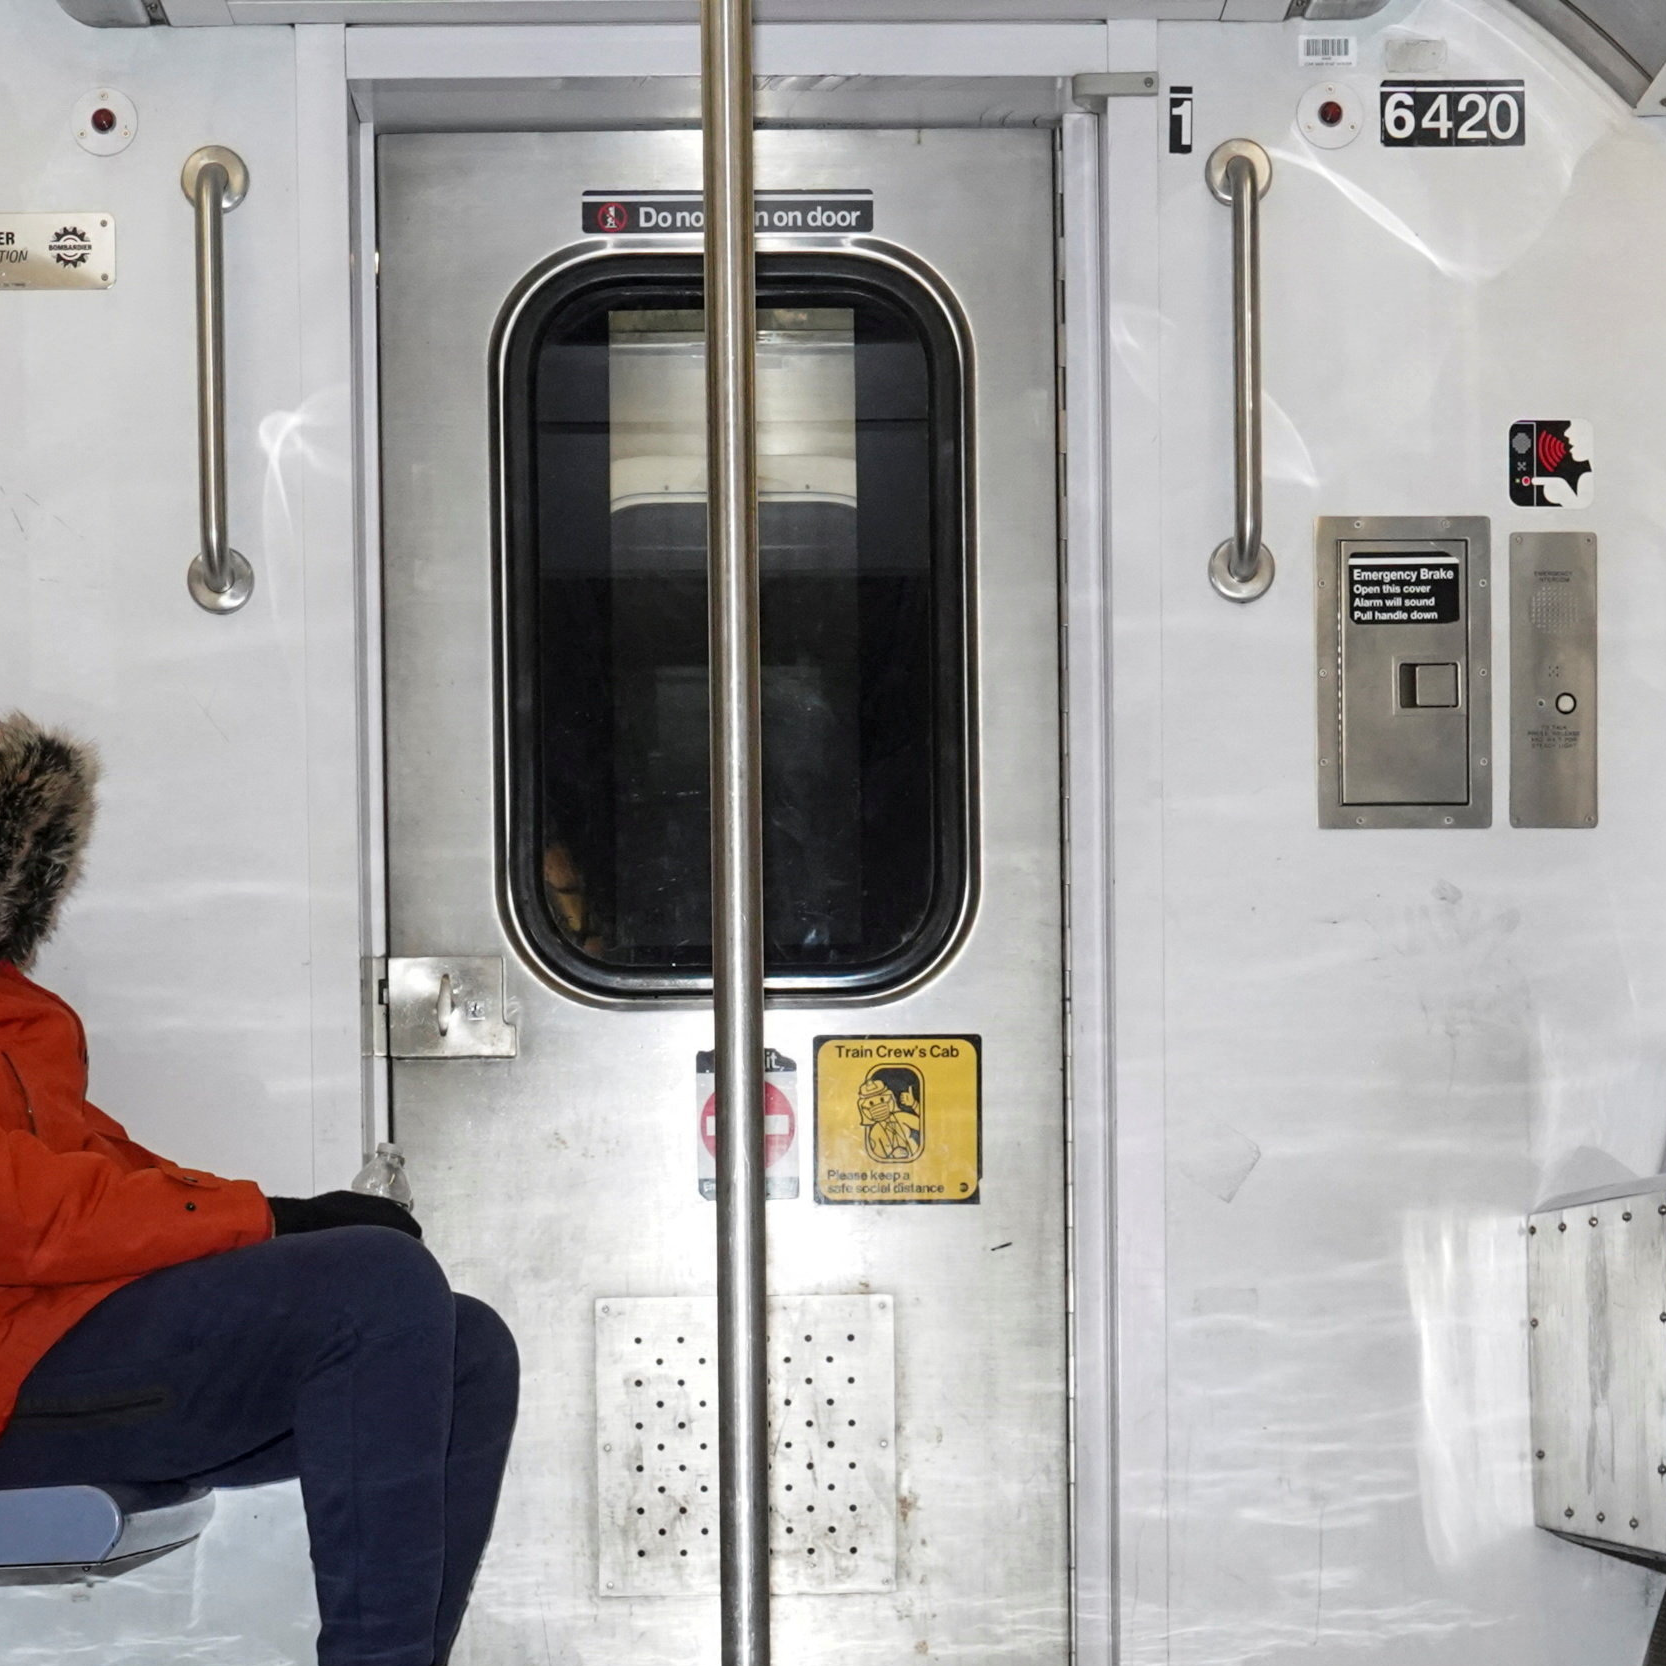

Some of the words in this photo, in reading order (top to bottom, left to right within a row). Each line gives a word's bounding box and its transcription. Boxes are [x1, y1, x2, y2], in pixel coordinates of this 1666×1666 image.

[1171, 100, 1192, 146] 1
[1384, 93, 1519, 140] 6420
[638, 206, 672, 228] Do
[676, 209, 704, 228] no
[773, 211, 801, 227] on
[807, 206, 860, 227] door
[1353, 569, 1417, 582] Emergency
[1420, 567, 1454, 580] Brake
[1353, 585, 1380, 595] Open
[1382, 584, 1401, 594] this
[1403, 585, 1431, 593] cover
[1353, 598, 1383, 607] Alarm
[1385, 597, 1402, 606] will
[1404, 597, 1435, 606] sound
[1354, 611, 1373, 620] Pull
[1375, 610, 1408, 620] handle
[1410, 610, 1438, 619] down
[835, 1045, 873, 1058] Train
[876, 1045, 926, 1058] Crew's
[929, 1045, 960, 1058] Cab
[827, 1169, 868, 1181] Please
[870, 1170, 900, 1182] keep
[902, 1172, 910, 1181] a
[827, 1183, 853, 1194] safe
[855, 1183, 891, 1194] social
[893, 1182, 945, 1194] distance
